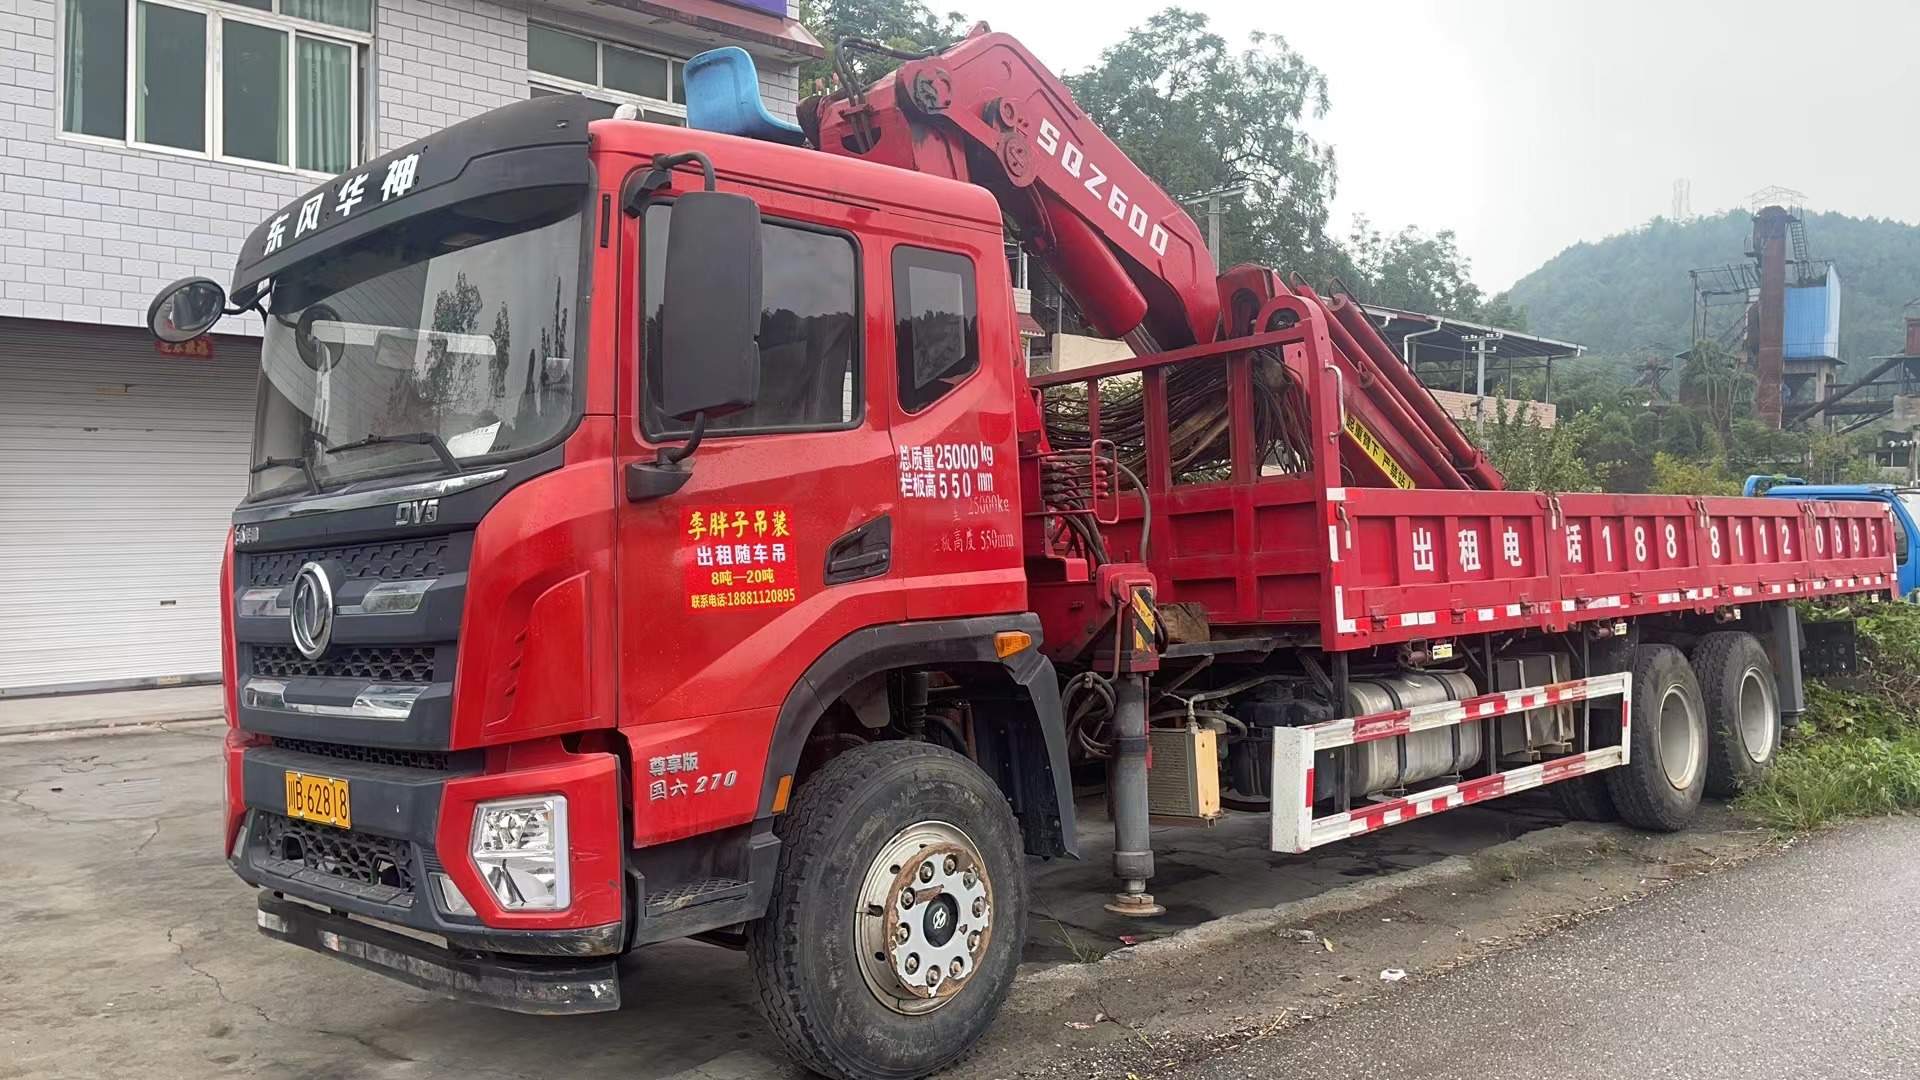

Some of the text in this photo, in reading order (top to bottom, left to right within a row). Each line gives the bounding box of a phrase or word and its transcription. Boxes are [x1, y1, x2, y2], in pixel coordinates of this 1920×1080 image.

[1036, 117, 1169, 257] SQZ600
[263, 153, 419, 256] 东风华神
[395, 498, 440, 526] DV5
[687, 509, 790, 541] 李胖子吊装
[696, 543, 787, 567] 出租随车吊
[648, 751, 699, 777] 尊享版
[694, 770, 738, 795] 270
